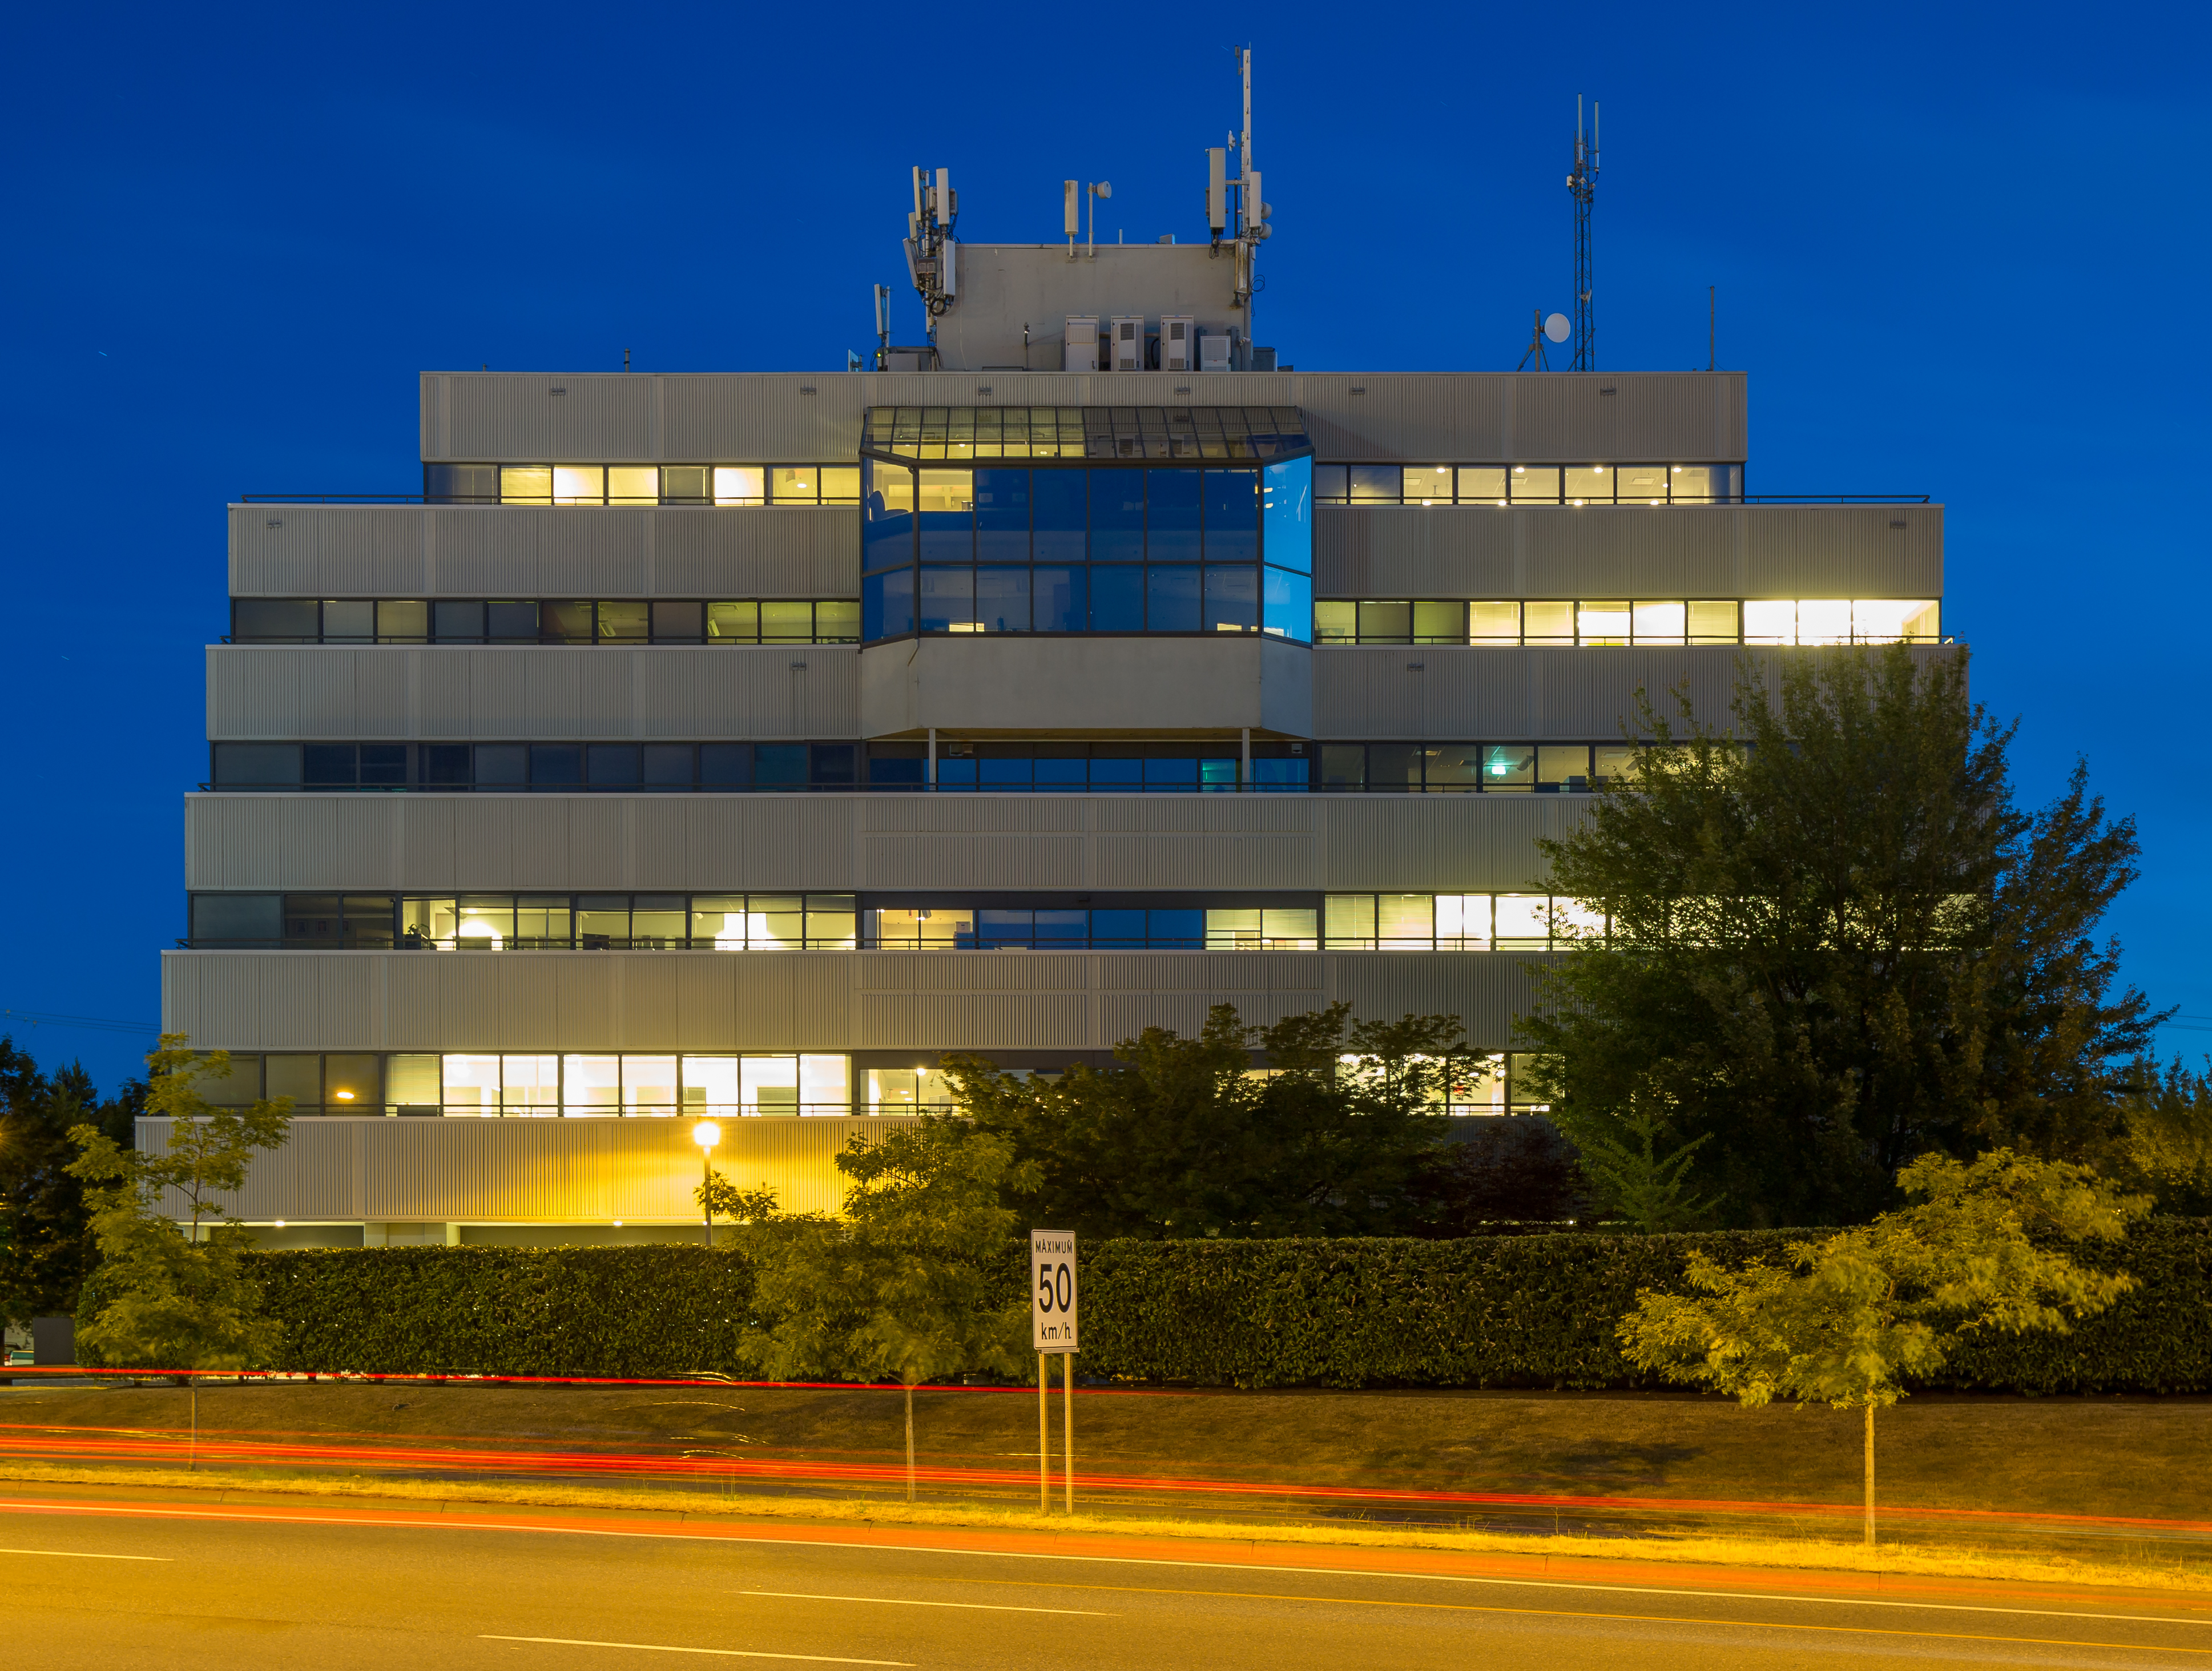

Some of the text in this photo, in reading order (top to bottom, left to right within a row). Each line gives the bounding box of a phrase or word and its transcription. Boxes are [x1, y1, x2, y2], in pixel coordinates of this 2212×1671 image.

[1036, 1240, 1073, 1254] MAXIMUM
[1038, 1263, 1071, 1313] 50
[1041, 1322, 1071, 1339] km/h
